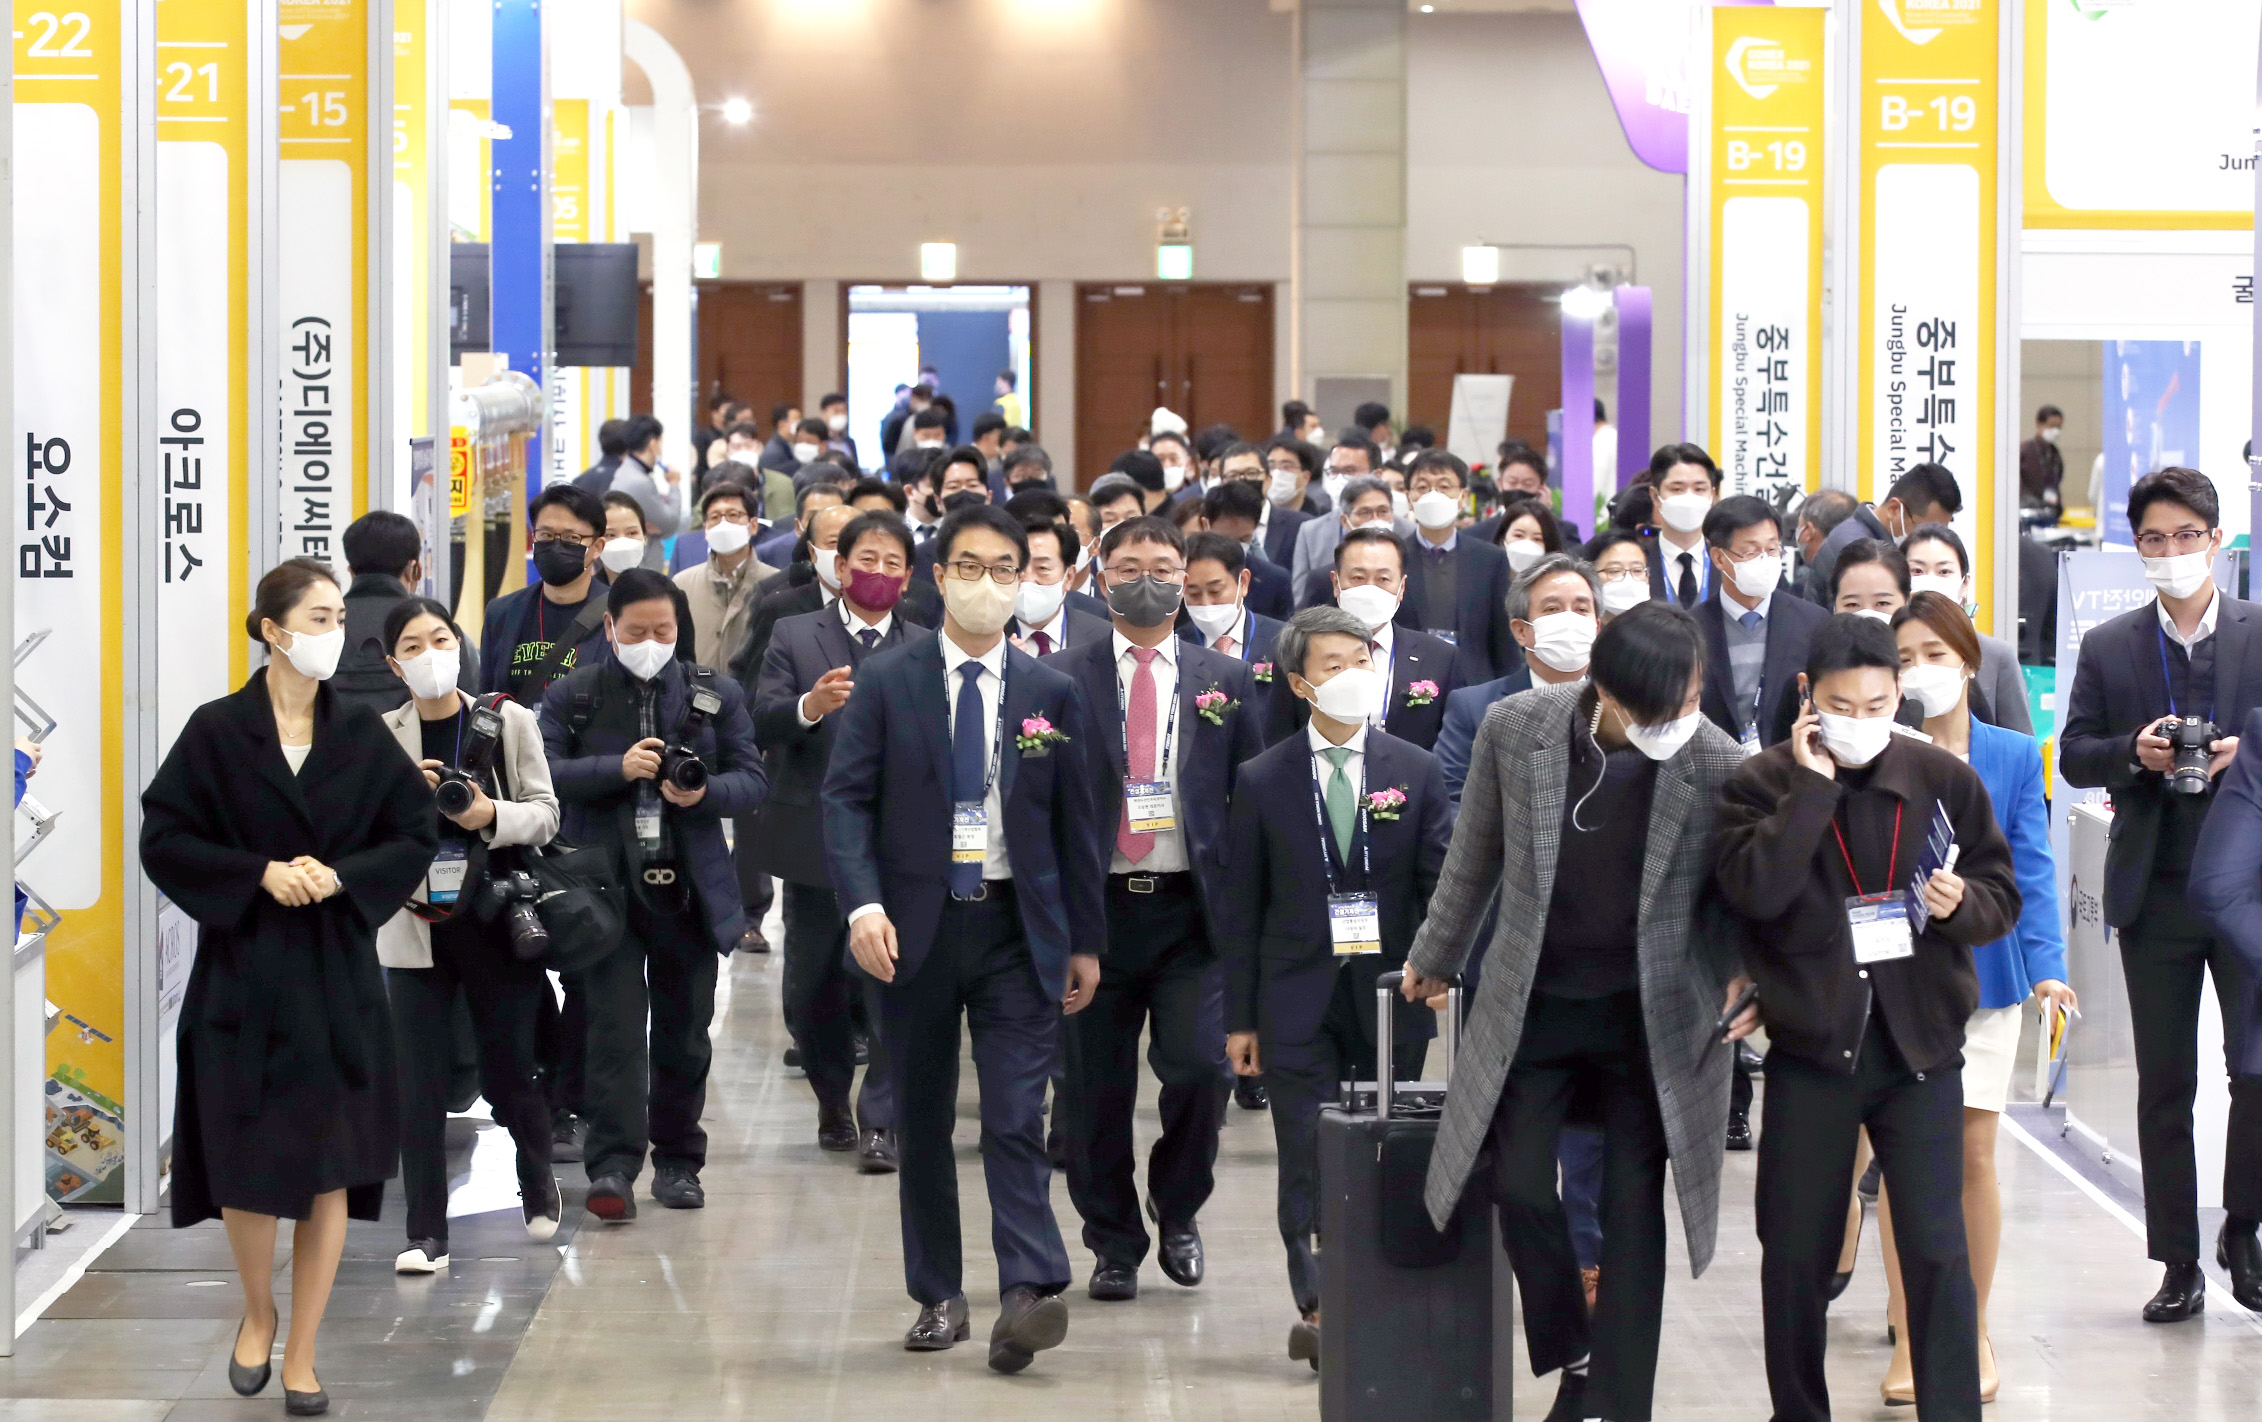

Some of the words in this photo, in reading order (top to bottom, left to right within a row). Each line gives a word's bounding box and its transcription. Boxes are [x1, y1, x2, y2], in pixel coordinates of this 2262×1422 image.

[2219, 154, 2256, 170] Jun
[1731, 313, 1749, 372] Jungbu
[1886, 303, 1907, 375] Jungbu
[1732, 376, 1748, 435] Special
[1886, 380, 1907, 452] Special
[1916, 317, 1956, 466] 중부특수
[160, 406, 205, 584] 아크로스
[1734, 439, 1748, 497] Machin
[19, 431, 73, 579] 요소컴
[435, 866, 462, 875] VISITOR
[1320, 837, 1328, 858] HYUNDAI
